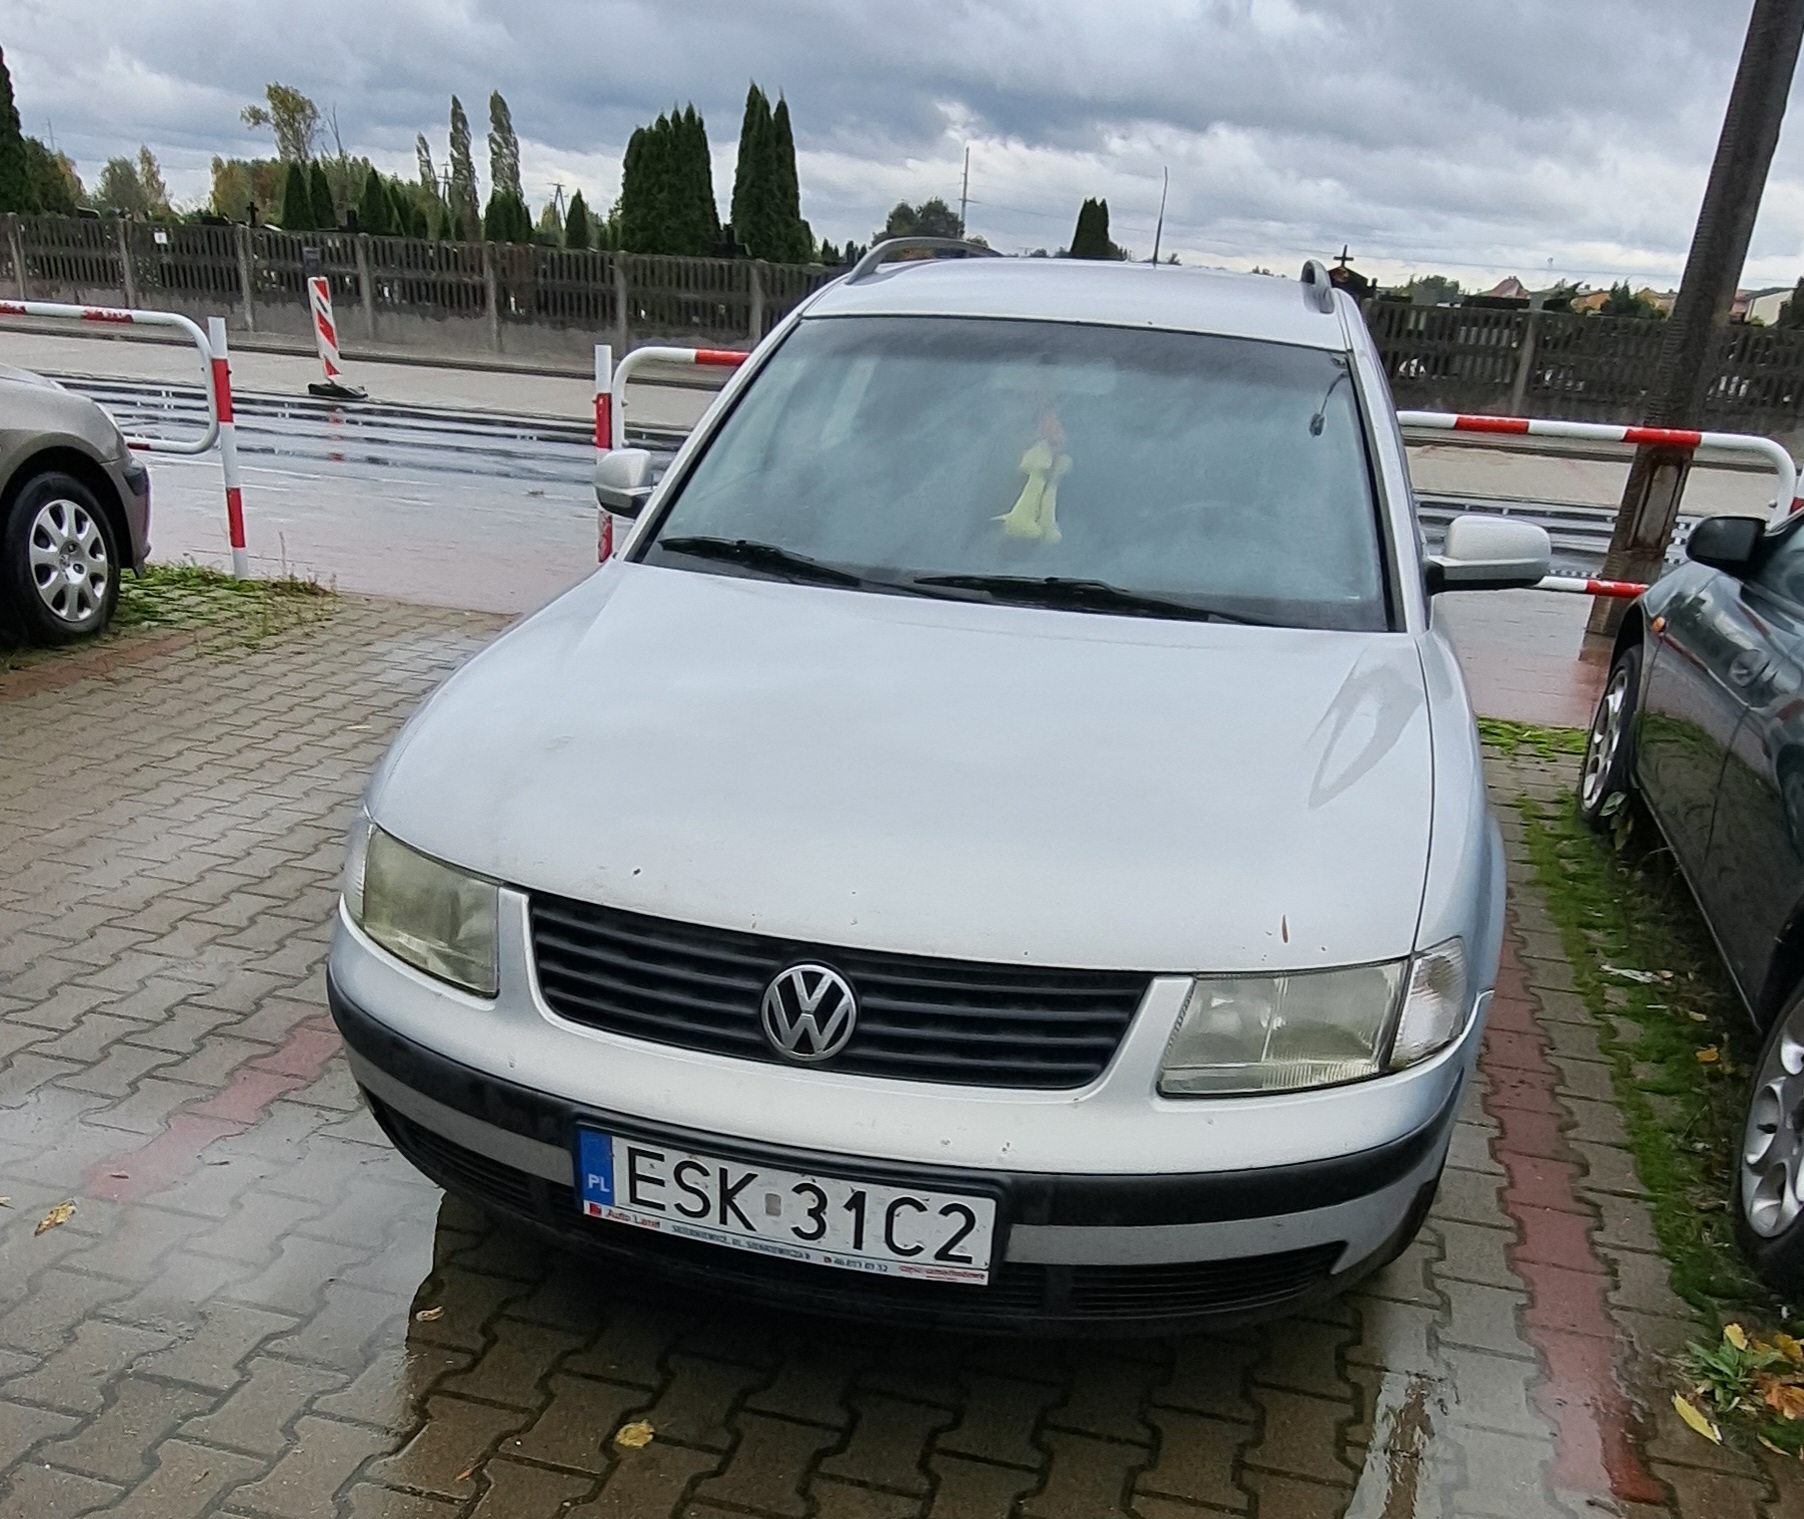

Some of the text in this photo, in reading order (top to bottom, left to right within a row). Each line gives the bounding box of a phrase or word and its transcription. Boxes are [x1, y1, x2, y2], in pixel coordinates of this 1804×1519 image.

[588, 1173, 610, 1192] PL
[627, 1146, 758, 1231] ESK
[791, 1183, 976, 1264] 31C2
